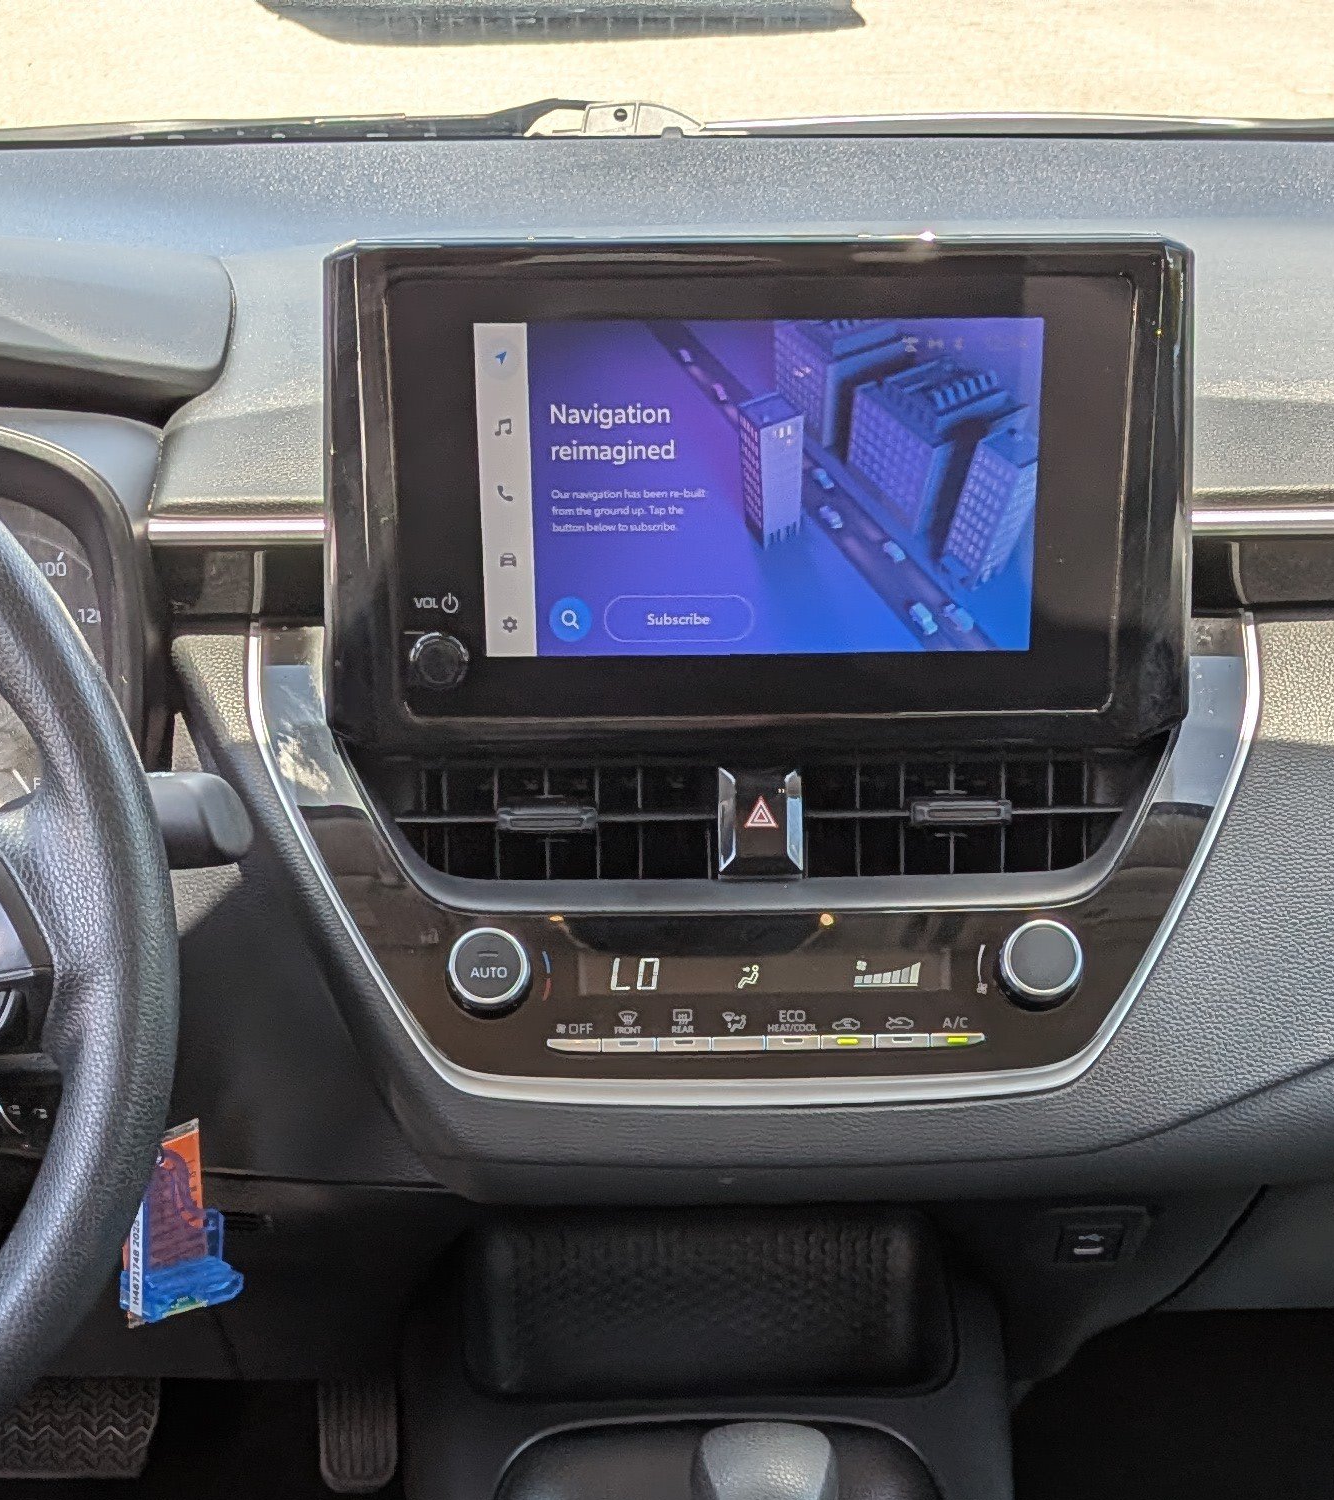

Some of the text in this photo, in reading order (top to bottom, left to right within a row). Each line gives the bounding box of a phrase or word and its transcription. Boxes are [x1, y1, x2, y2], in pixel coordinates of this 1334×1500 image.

[550, 403, 671, 429] Navigation
[551, 439, 675, 465] reimagined
[551, 488, 706, 501] Our navigation has been re-built
[551, 505, 684, 518] from the ground up. Tap the
[552, 523, 586, 533] button
[586, 523, 616, 533] below
[618, 523, 628, 532] to
[414, 597, 438, 609] VOL
[647, 613, 711, 627] Subscribe
[33, 776, 42, 790] F
[470, 965, 508, 979] AUTO
[610, 957, 660, 991] LO
[779, 1010, 806, 1023] ECO
[942, 1017, 969, 1029] A/C
[568, 1022, 594, 1035] OFF
[614, 1025, 641, 1035] FRONT
[671, 1025, 694, 1034] REAR
[767, 1023, 817, 1033] HEAT/COOL
